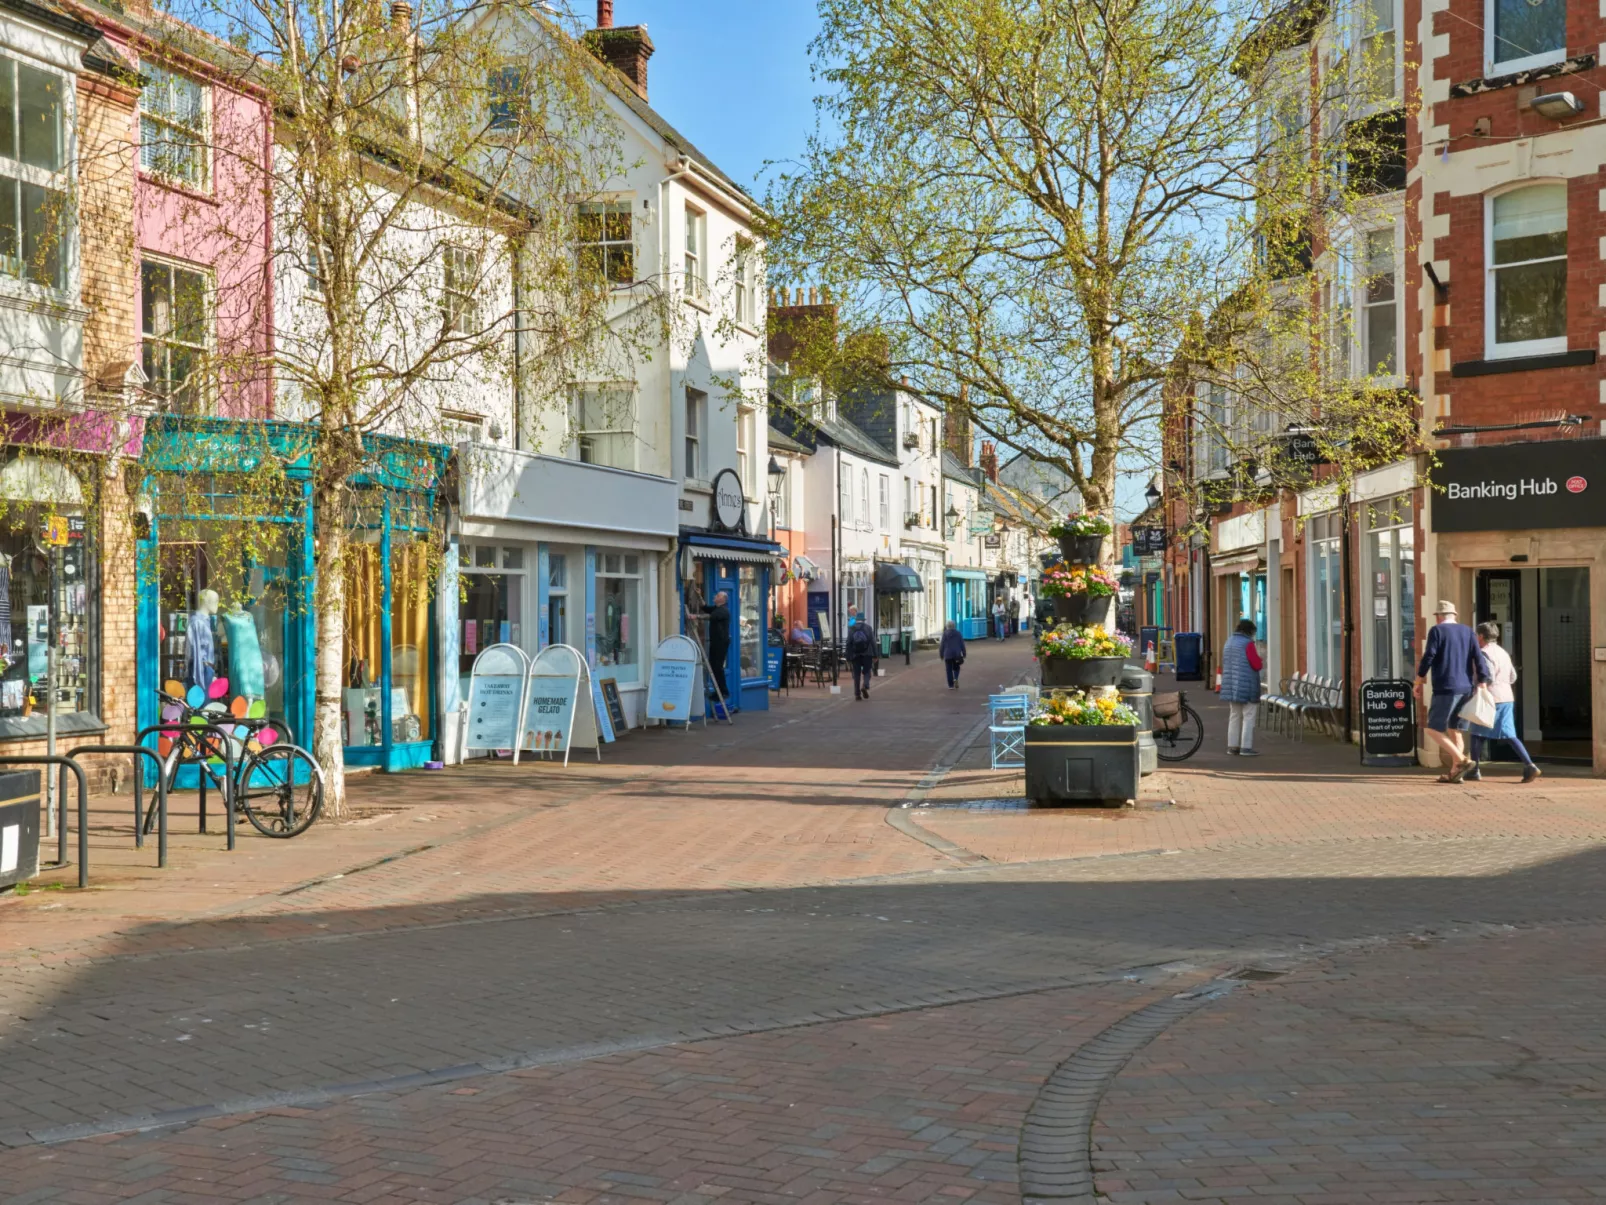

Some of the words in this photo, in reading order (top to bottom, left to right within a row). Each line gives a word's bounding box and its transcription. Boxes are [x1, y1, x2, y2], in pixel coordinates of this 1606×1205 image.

[1448, 480, 1517, 500] Banking
[1520, 477, 1558, 496] Hub
[1367, 690, 1405, 700] Banking
[533, 697, 568, 706] HOMEMADE
[1367, 701, 1388, 710] Hub
[538, 706, 561, 714] GELATO
